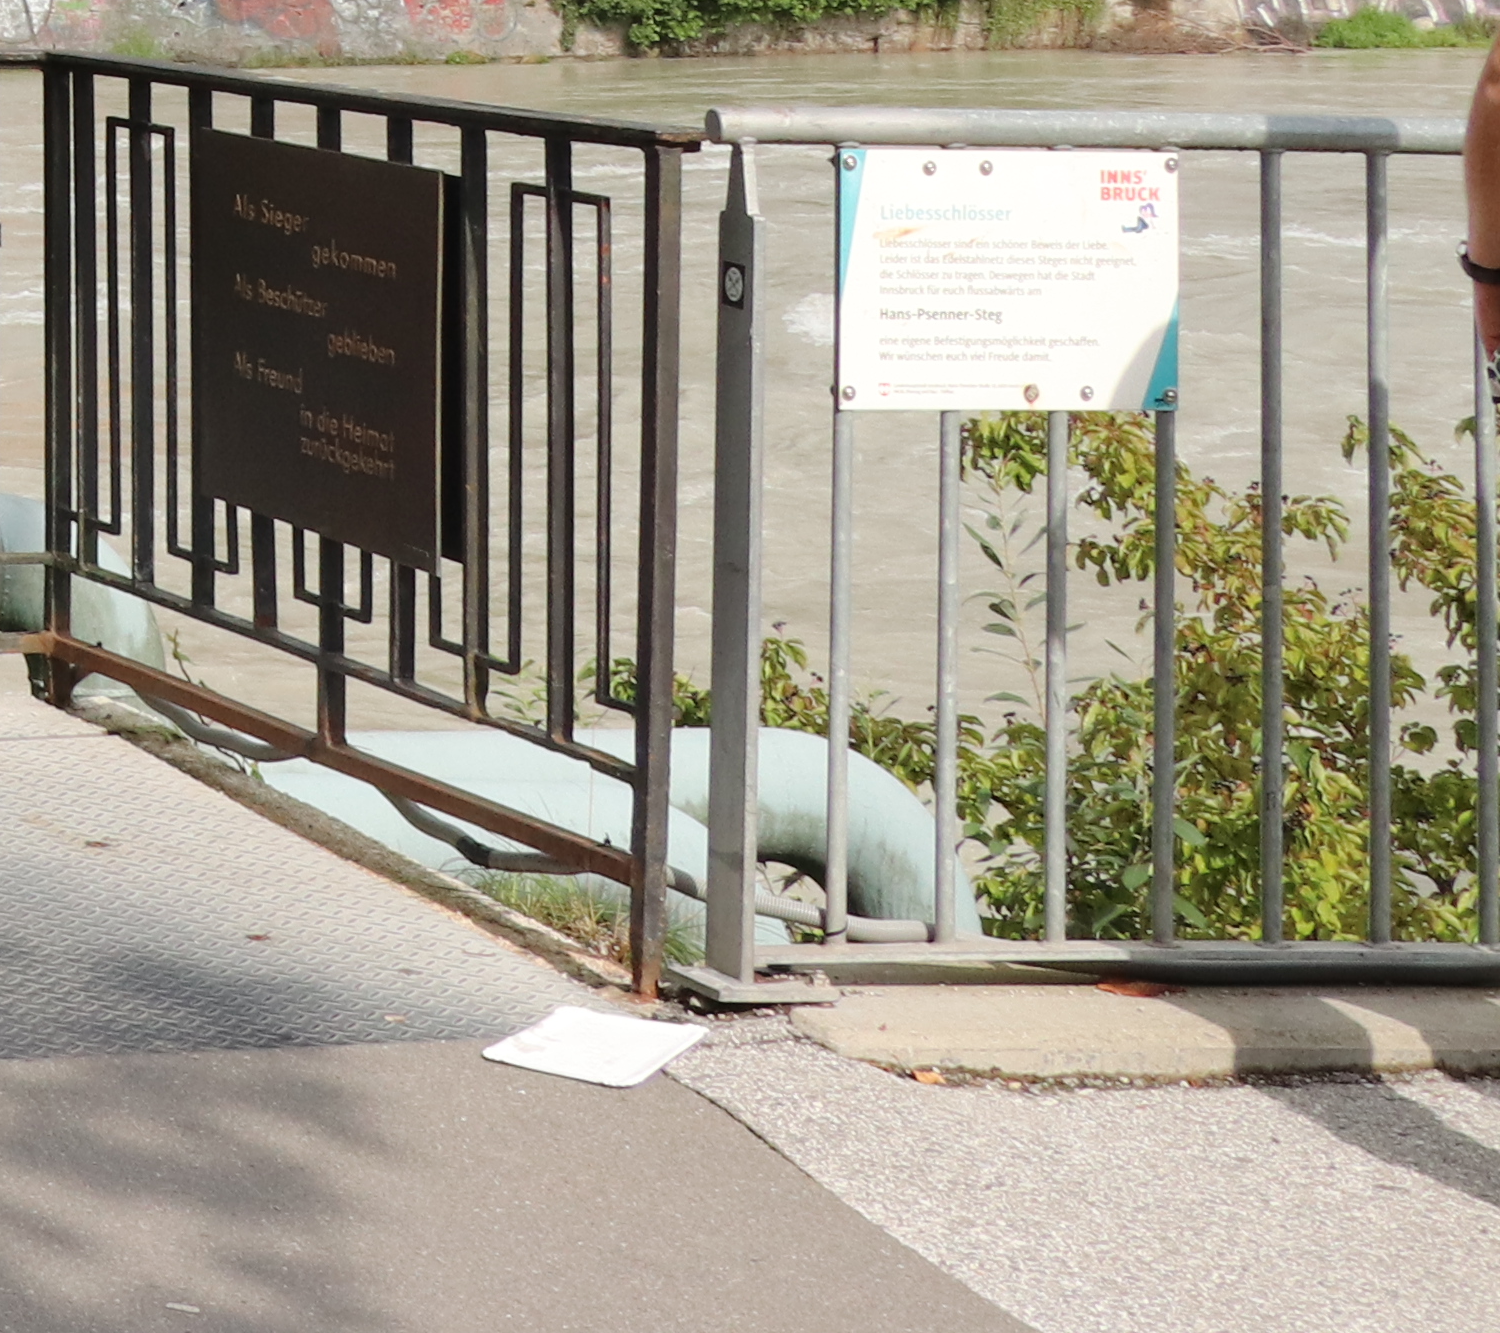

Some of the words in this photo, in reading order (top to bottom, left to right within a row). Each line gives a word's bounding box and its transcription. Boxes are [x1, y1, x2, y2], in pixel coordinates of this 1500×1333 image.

[1100, 186, 1160, 201] BRUCK
[233, 193, 255, 221] Als
[260, 199, 309, 235] Sieger
[880, 203, 1012, 221] Liebesschlösser
[879, 237, 951, 249] Liebesschlösser
[953, 238, 973, 249] sind
[975, 239, 990, 249] ein
[992, 239, 1028, 250] schöner
[1031, 239, 1063, 250] Beweis
[1065, 240, 1080, 250] der
[1082, 239, 1109, 251] Liebe.
[311, 238, 397, 280] gekommen
[879, 253, 908, 264] Leider
[910, 254, 921, 264] ist
[923, 254, 940, 264] das
[942, 254, 1004, 265] Edelstahlnetz
[1006, 255, 1036, 265] dieses
[1038, 255, 1068, 268] Steges
[1070, 255, 1093, 266] nicht
[1095, 256, 1137, 269] geeignet,
[879, 269, 894, 280] die
[896, 269, 939, 280] Schlösser
[941, 272, 953, 280] zu
[955, 271, 986, 283] tragen.
[989, 270, 1035, 283] Deswegen
[1037, 270, 1052, 281] hat
[1054, 270, 1069, 281] die
[1071, 270, 1095, 281] Stadt
[234, 273, 253, 300] Als
[258, 278, 328, 318] Beschützer
[879, 284, 925, 295] Innsbruck
[927, 284, 940, 295] für
[942, 285, 965, 296] euch
[967, 285, 1025, 296] flussabwärts
[1027, 288, 1042, 296] am
[879, 308, 1003, 324] Hans-Psenner-Steg
[327, 328, 396, 366] geblieben
[879, 336, 899, 346] eine
[901, 336, 931, 349] eigene
[934, 335, 1046, 349] Befestigungsmöglichkeit
[1048, 336, 1100, 349] geschaffen.
[879, 351, 894, 361] Wir
[896, 351, 943, 361] wünschen
[945, 351, 968, 361] euch
[970, 351, 986, 361] viel
[988, 351, 1020, 362] Freude
[1022, 351, 1051, 362] damit.
[234, 351, 253, 380] Als
[257, 358, 303, 395] Freund
[299, 404, 313, 429] in
[316, 405, 338, 435] die
[342, 413, 395, 453] Heimat
[299, 436, 395, 481] zurückgekehrt
